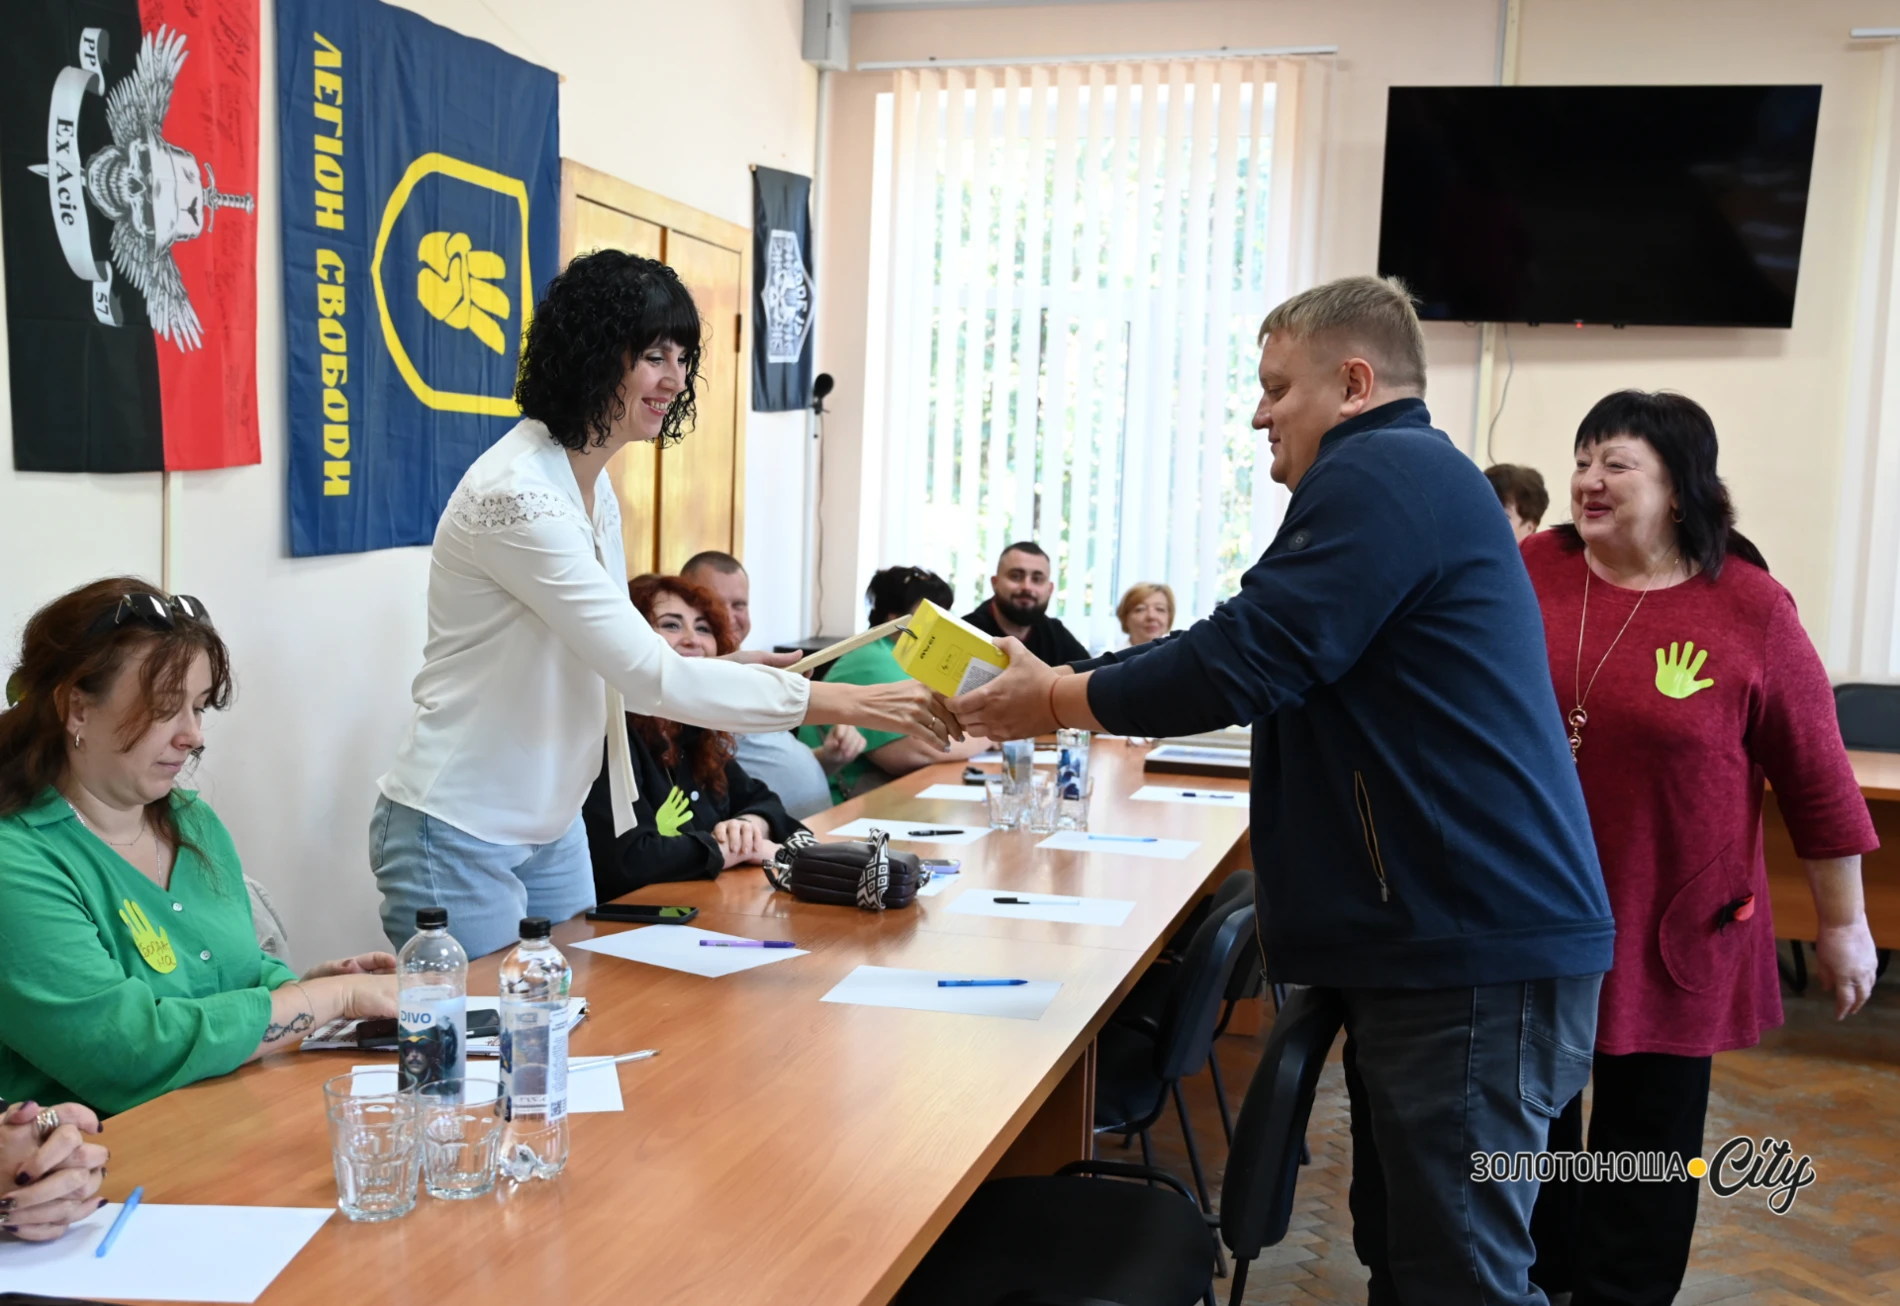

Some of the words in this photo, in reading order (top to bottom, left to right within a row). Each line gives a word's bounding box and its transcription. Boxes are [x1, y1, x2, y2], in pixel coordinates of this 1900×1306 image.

[56, 116, 75, 154] Ex
[313, 31, 345, 231] ЛЕГІОН
[56, 160, 78, 226] Acie
[96, 291, 109, 316] 57
[315, 248, 351, 496] СВОБОДИ
